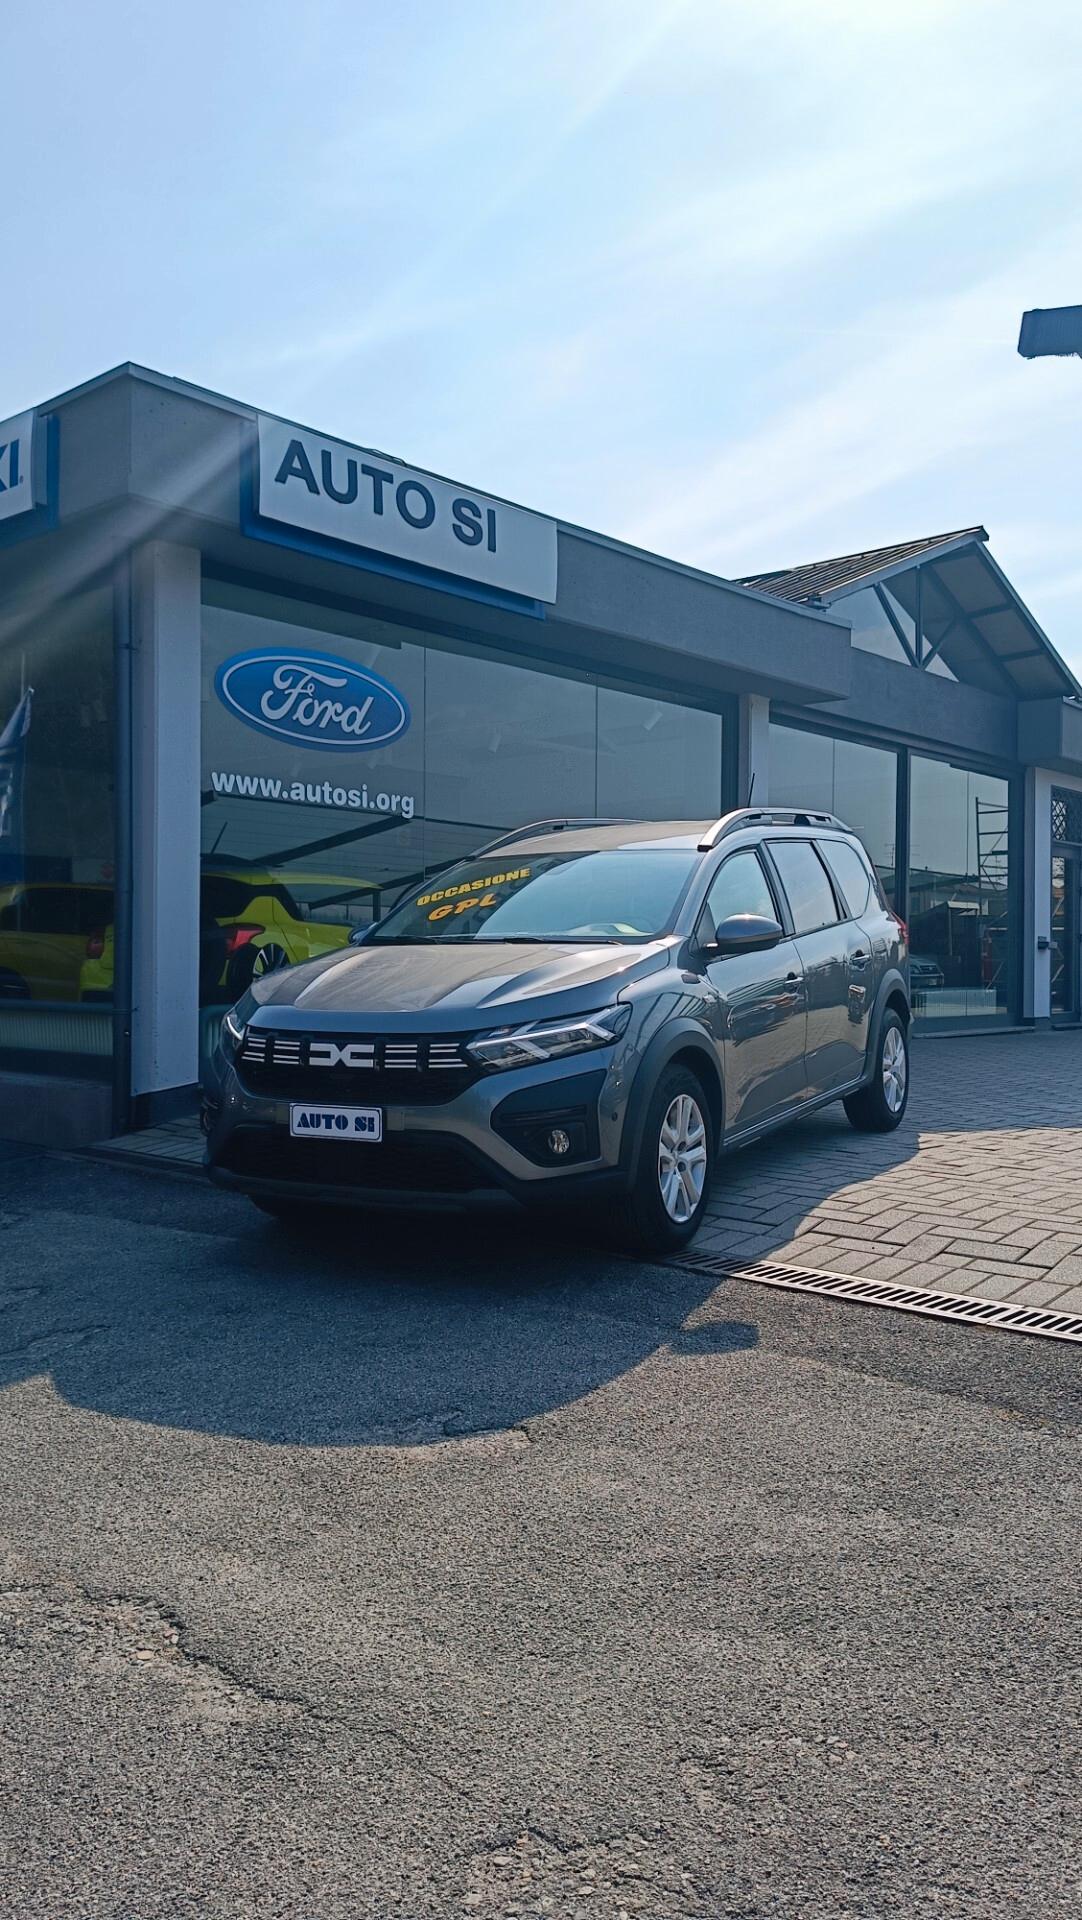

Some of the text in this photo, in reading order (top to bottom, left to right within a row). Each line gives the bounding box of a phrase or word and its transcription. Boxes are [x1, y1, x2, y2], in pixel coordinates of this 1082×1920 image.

[274, 439, 497, 553] AUTO SI
[260, 664, 375, 735] Ford
[211, 771, 415, 819] www.autosi.org
[416, 867, 531, 906] OCCASIONE
[428, 893, 497, 921] GPL
[296, 1112, 375, 1133] AUTO SI
